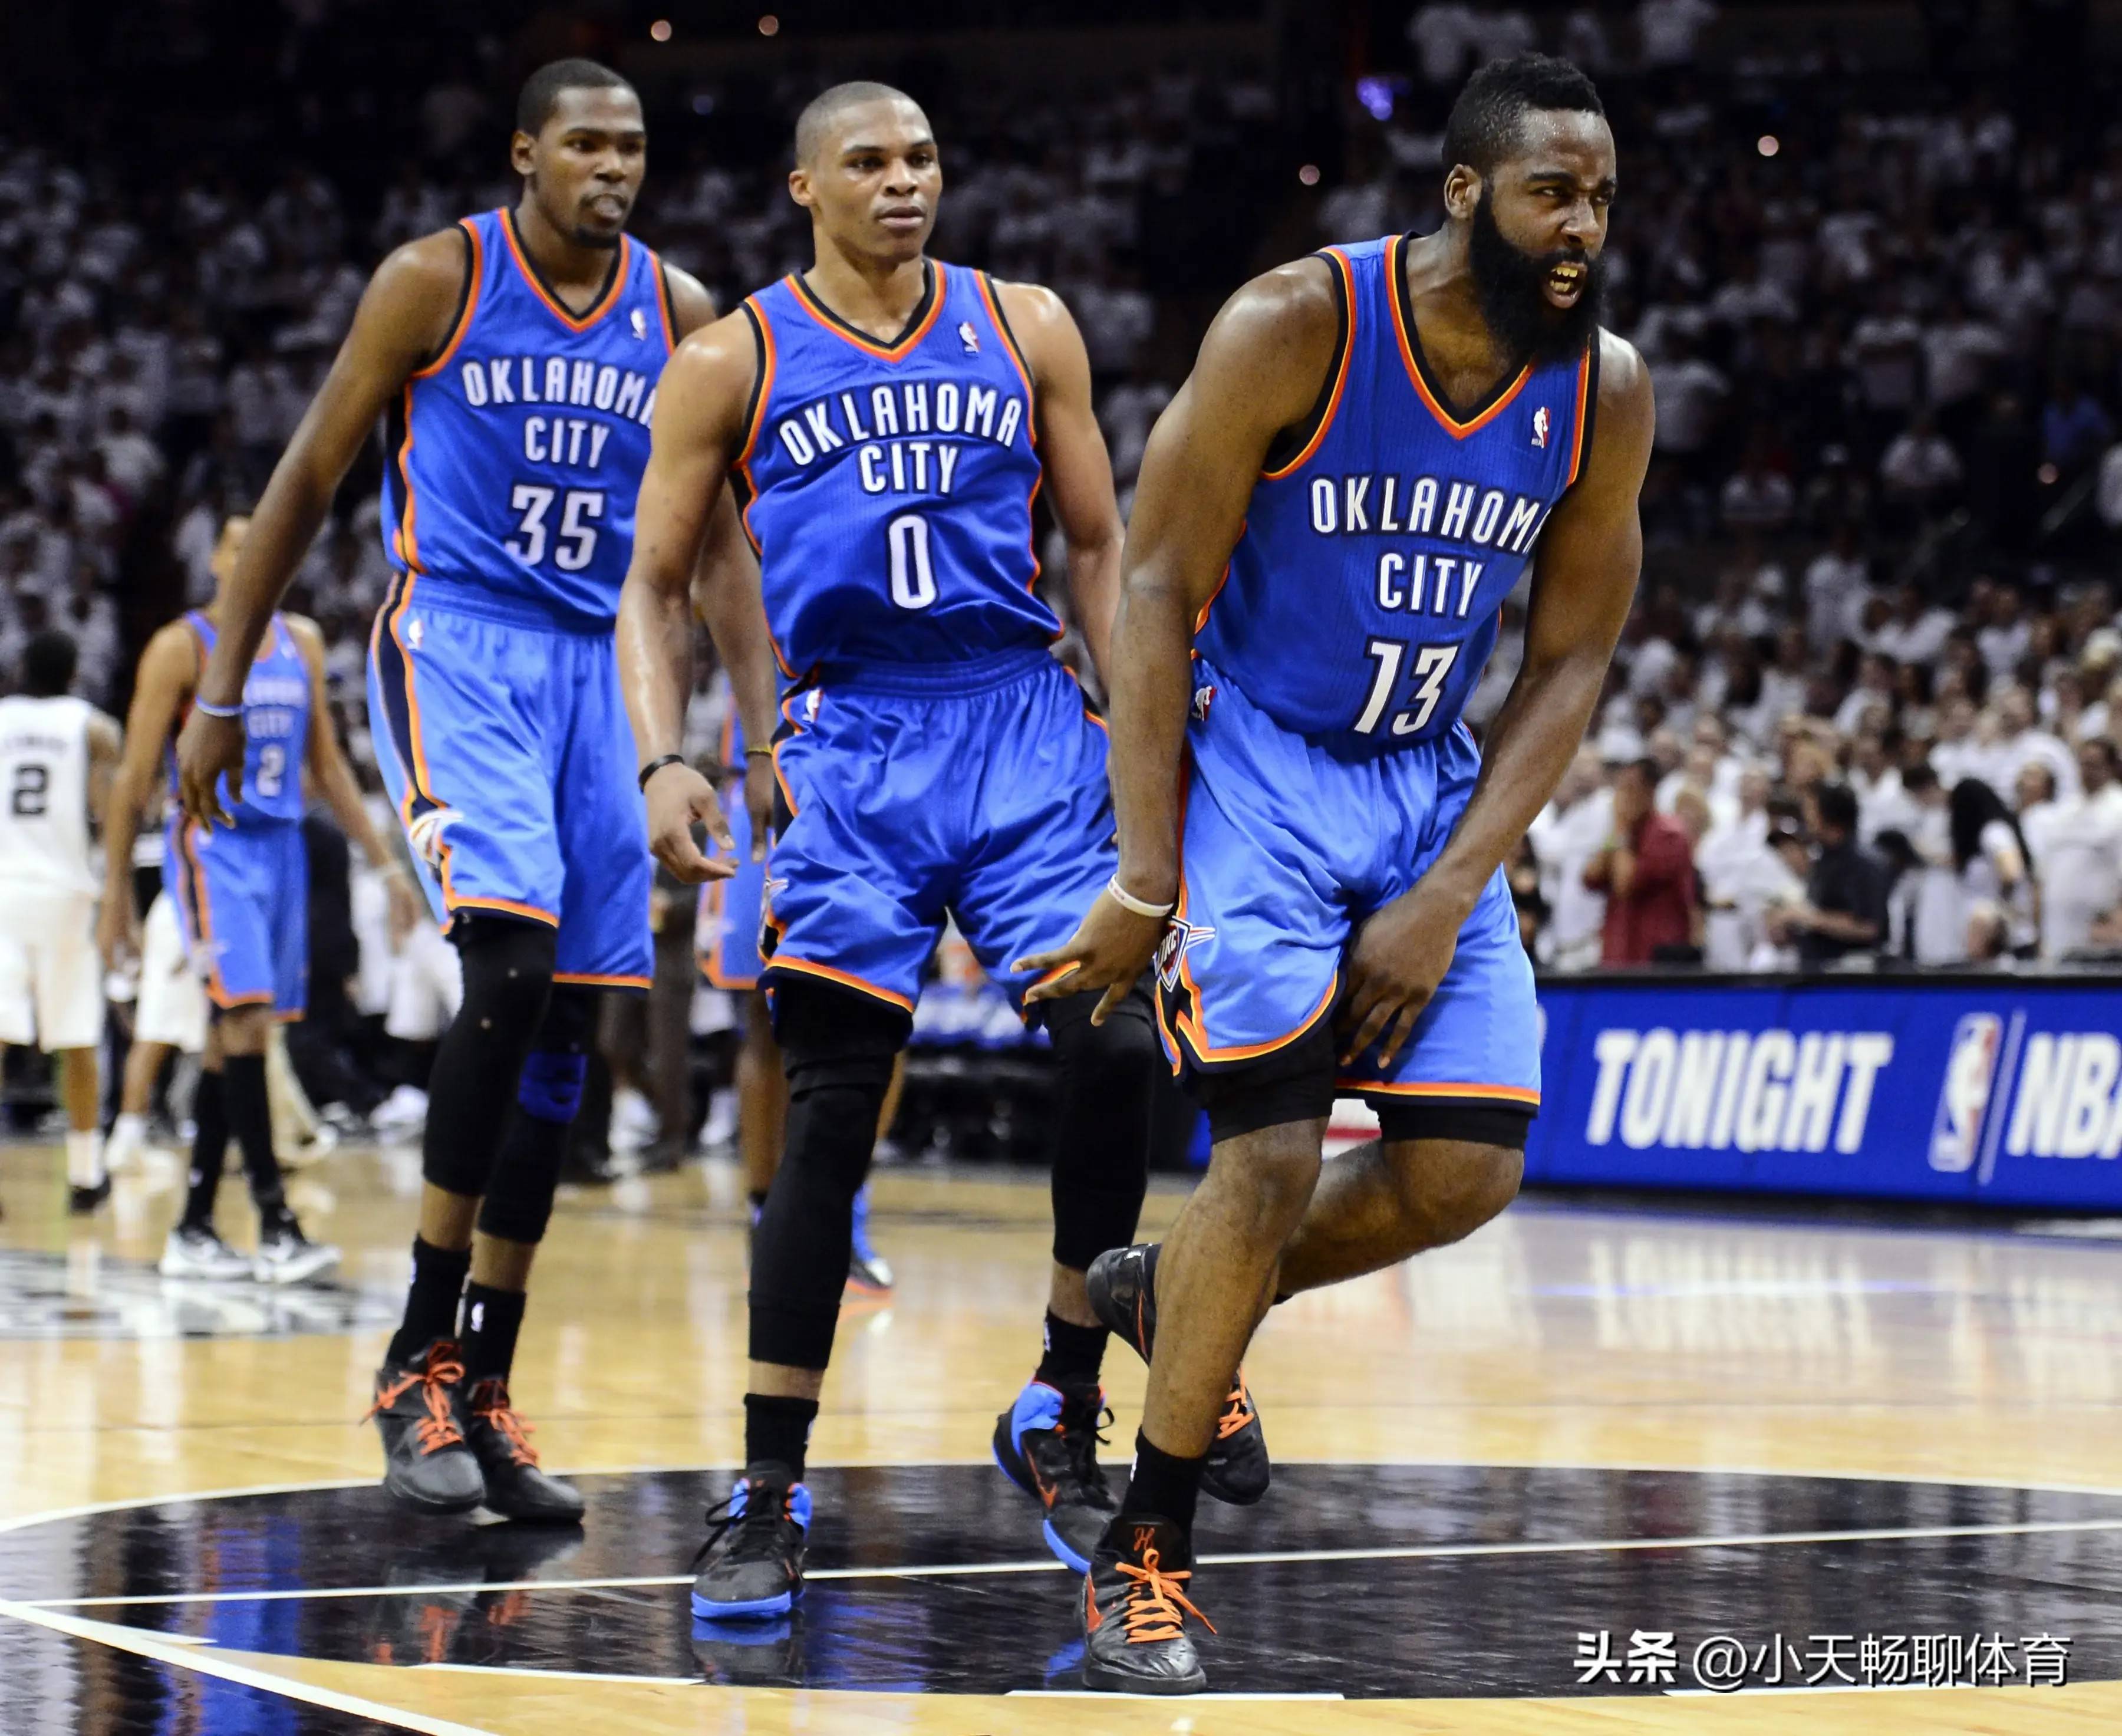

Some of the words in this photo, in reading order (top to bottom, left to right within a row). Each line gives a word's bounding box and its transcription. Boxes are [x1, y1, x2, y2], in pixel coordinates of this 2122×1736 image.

[525, 416, 610, 469] CITY
[779, 383, 1022, 466] OKLAHOMA
[859, 442, 959, 494] CITY
[505, 484, 605, 571] 35
[888, 513, 937, 610] 0
[1380, 553, 1485, 617] CITY
[1354, 641, 1458, 736] 13
[12, 763, 49, 816] 2
[256, 743, 286, 797] 2
[1586, 1027, 1894, 1155] TONIGHT
